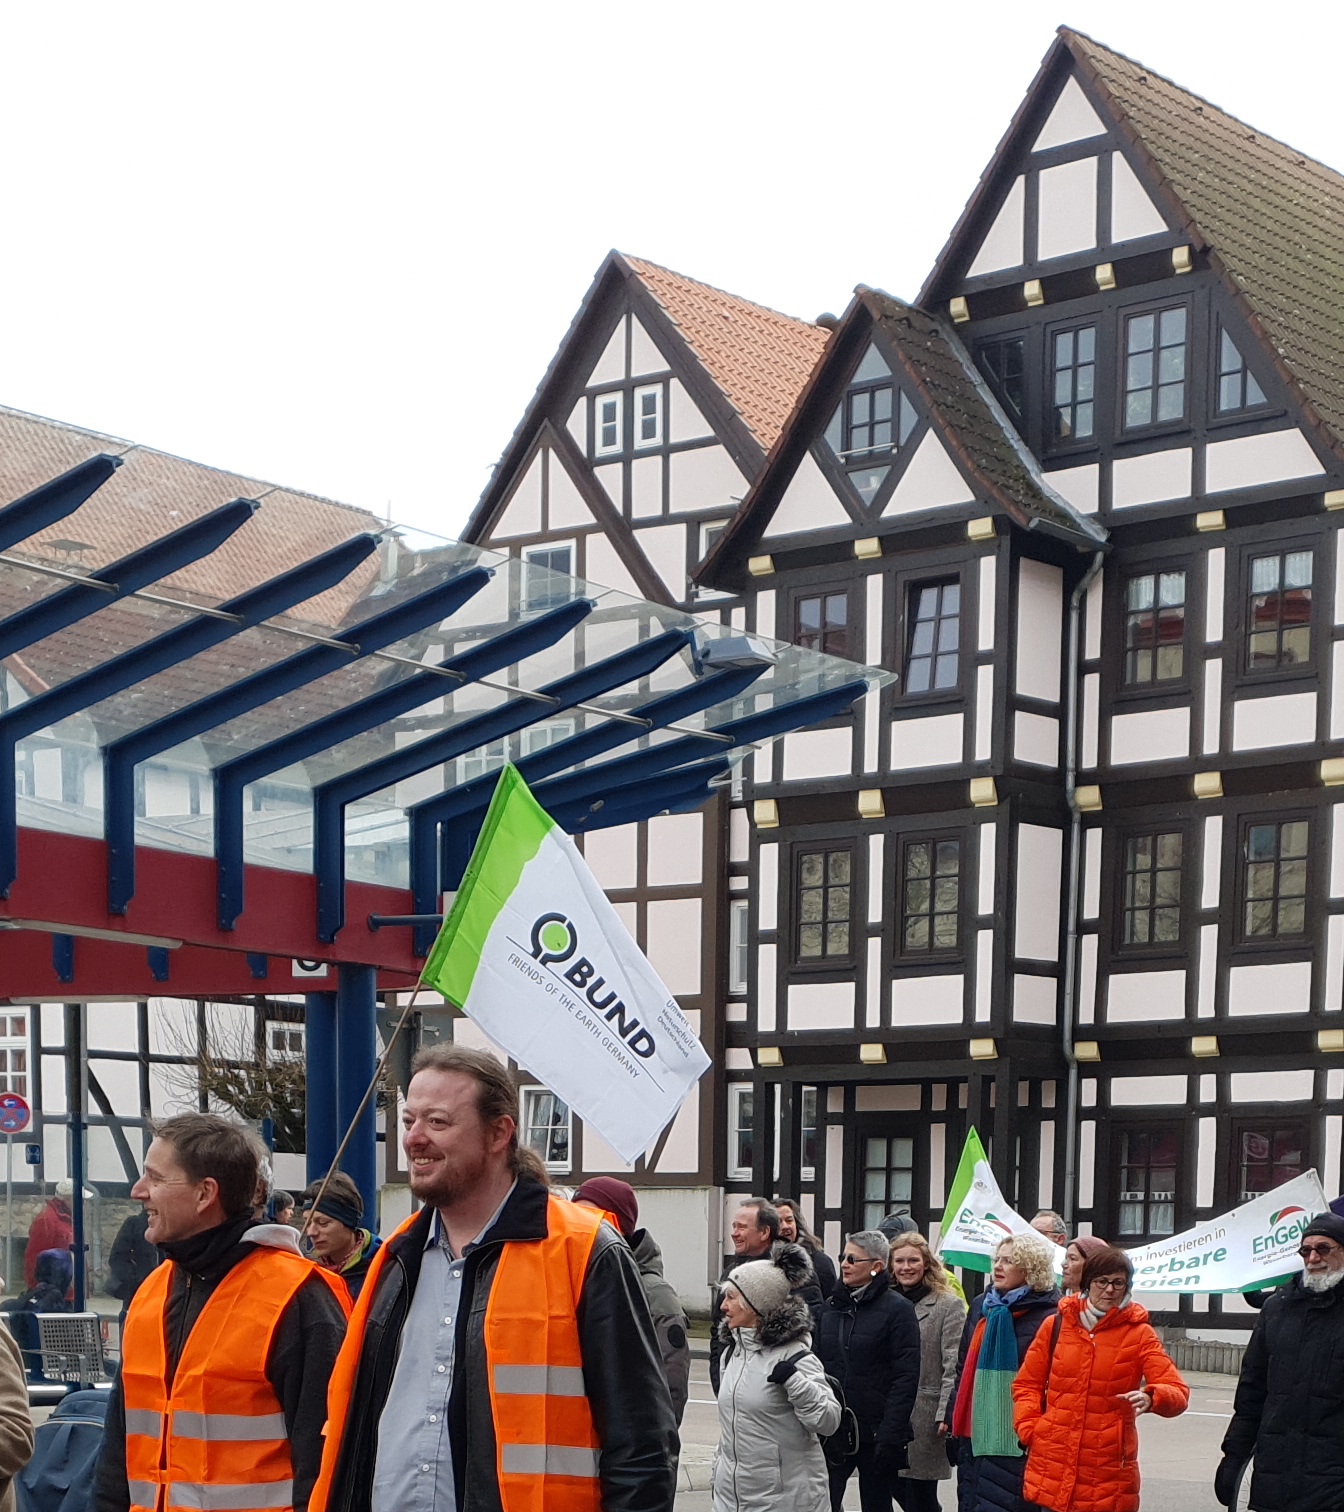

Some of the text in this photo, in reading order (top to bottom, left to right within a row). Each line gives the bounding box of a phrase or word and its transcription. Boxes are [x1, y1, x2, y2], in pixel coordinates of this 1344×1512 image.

[507, 953, 641, 1079] FRIENDS OF THE EARTH GERMANY
[563, 956, 656, 1058] BUND
[1146, 1231, 1213, 1262] investieren
[1215, 1228, 1226, 1240] in
[1253, 1211, 1324, 1255] EnGeW
